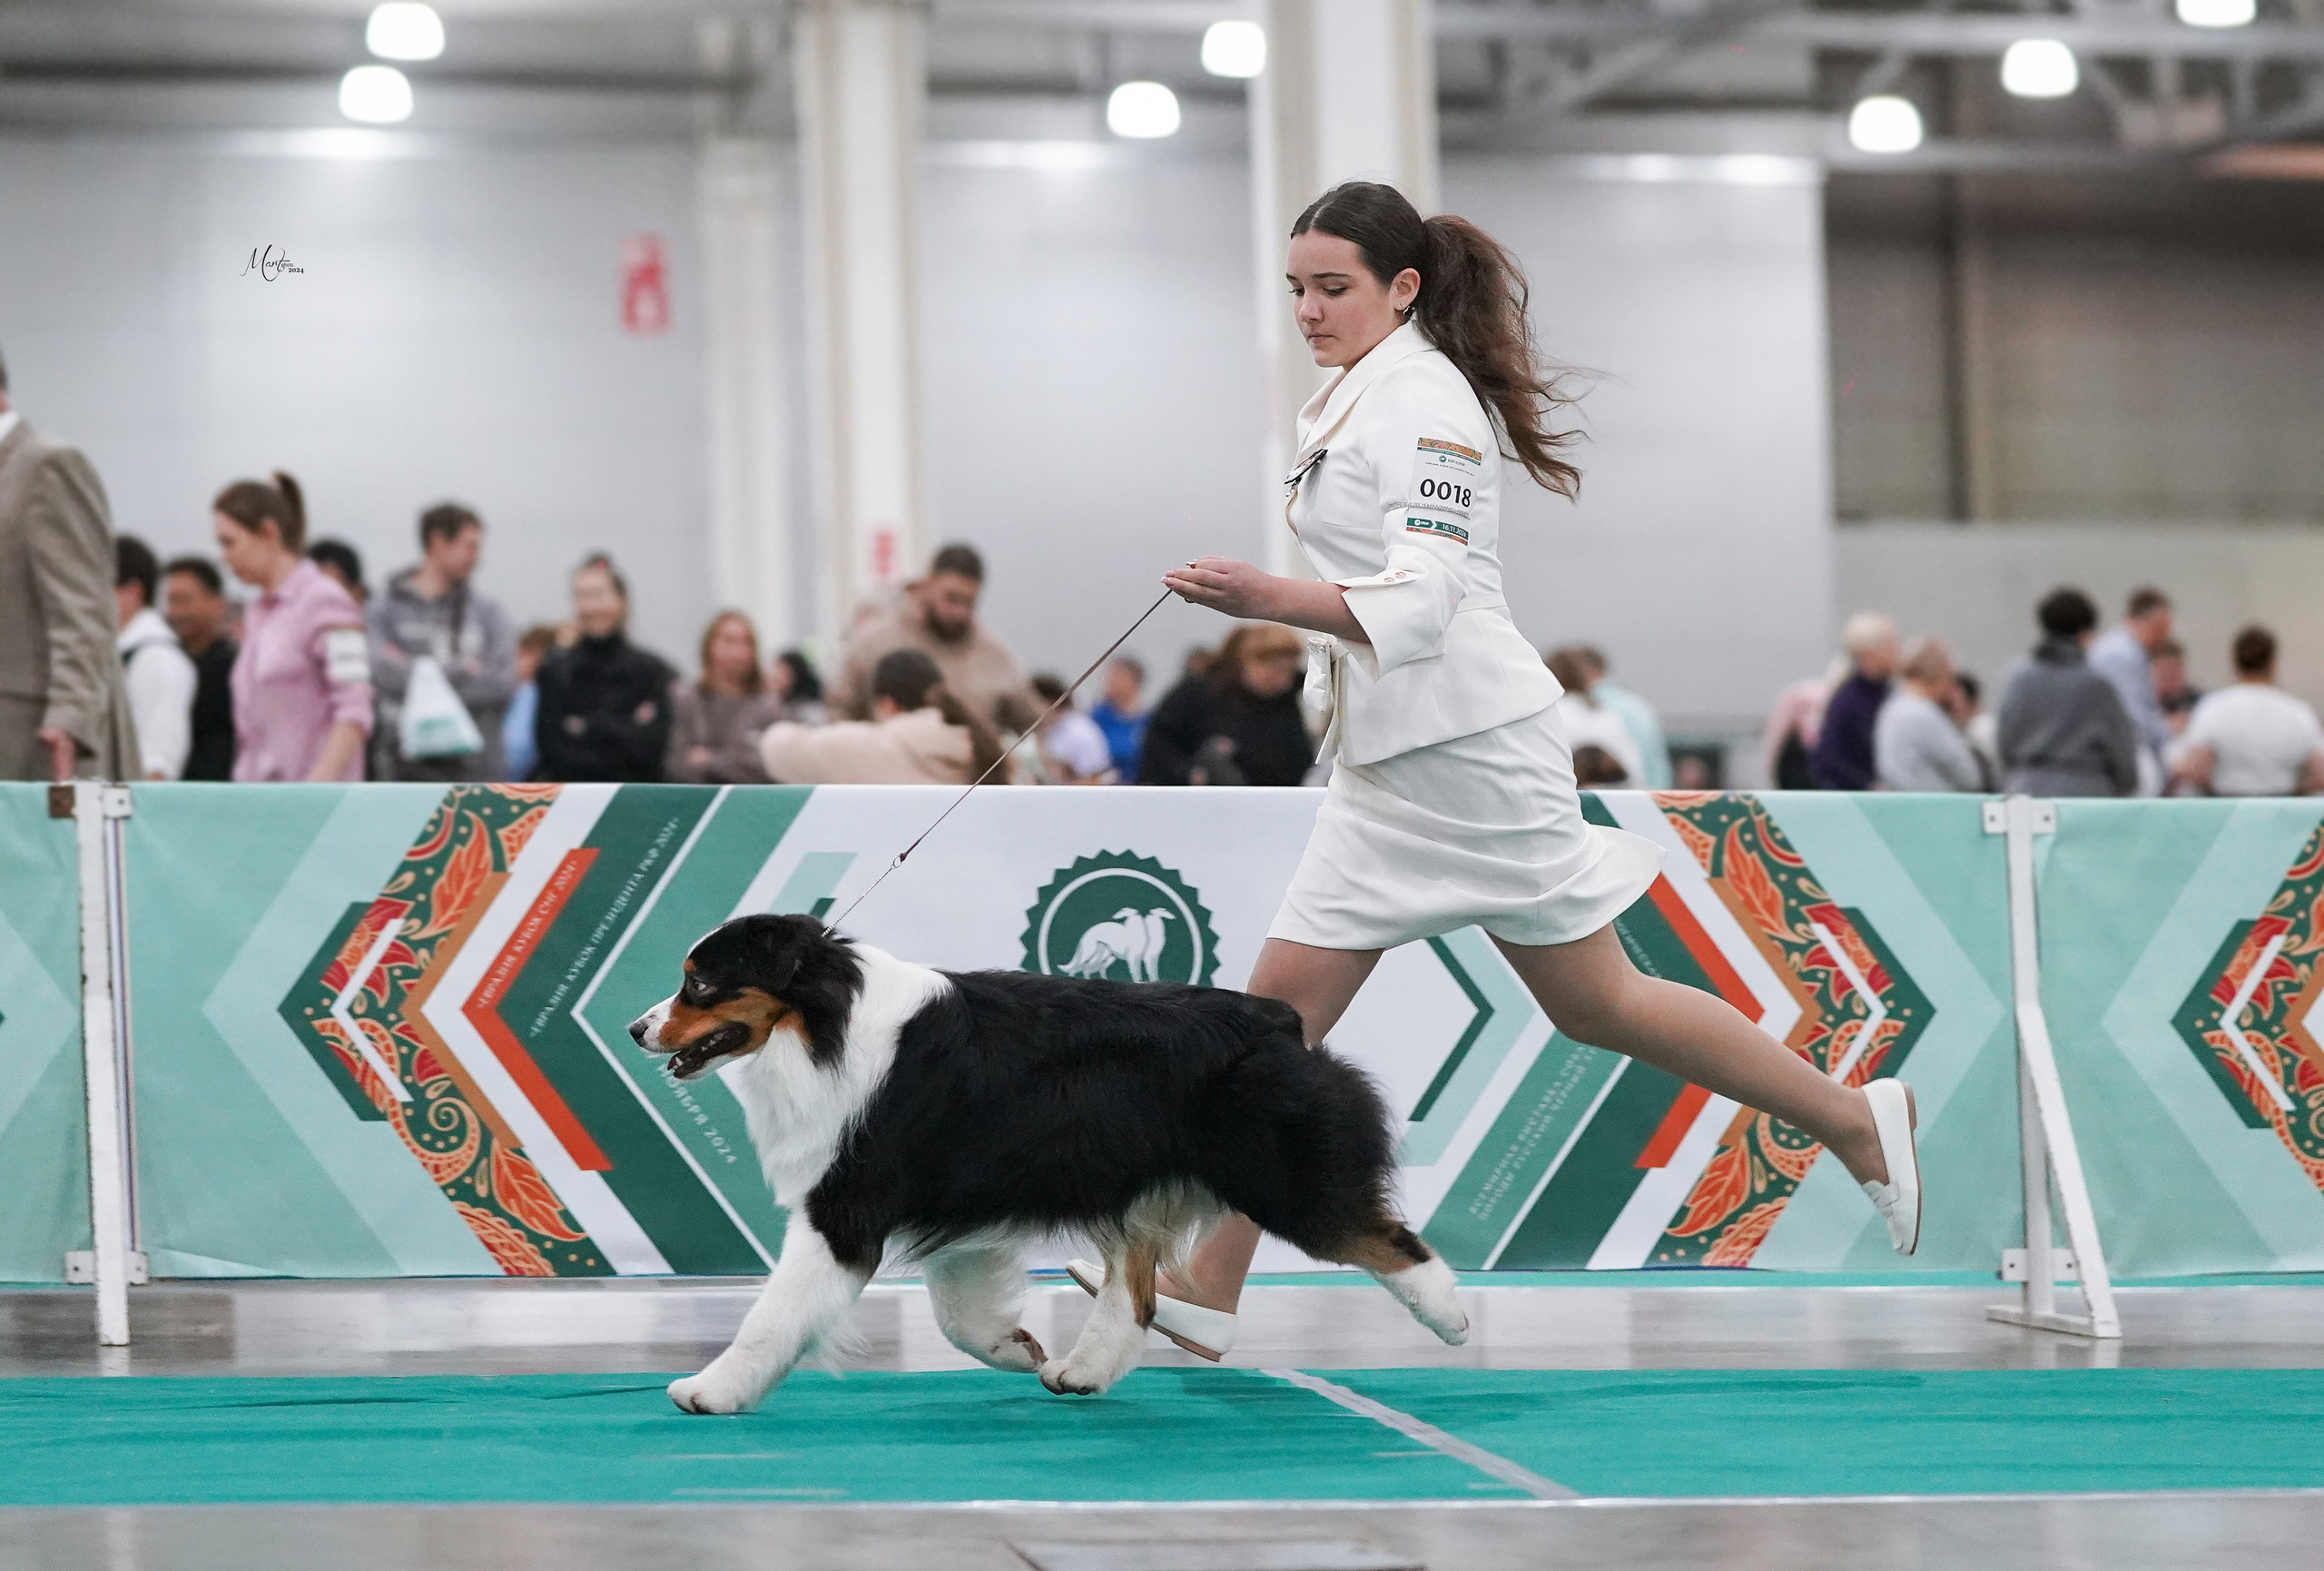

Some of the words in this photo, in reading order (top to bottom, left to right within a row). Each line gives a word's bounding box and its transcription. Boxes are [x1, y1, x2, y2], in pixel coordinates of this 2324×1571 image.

[1420, 479, 1472, 508] 0018
[1442, 523, 1467, 538] 16.11.2024
[656, 1063, 708, 1125] НОЯБРЯ
[704, 1128, 737, 1163] 2024
